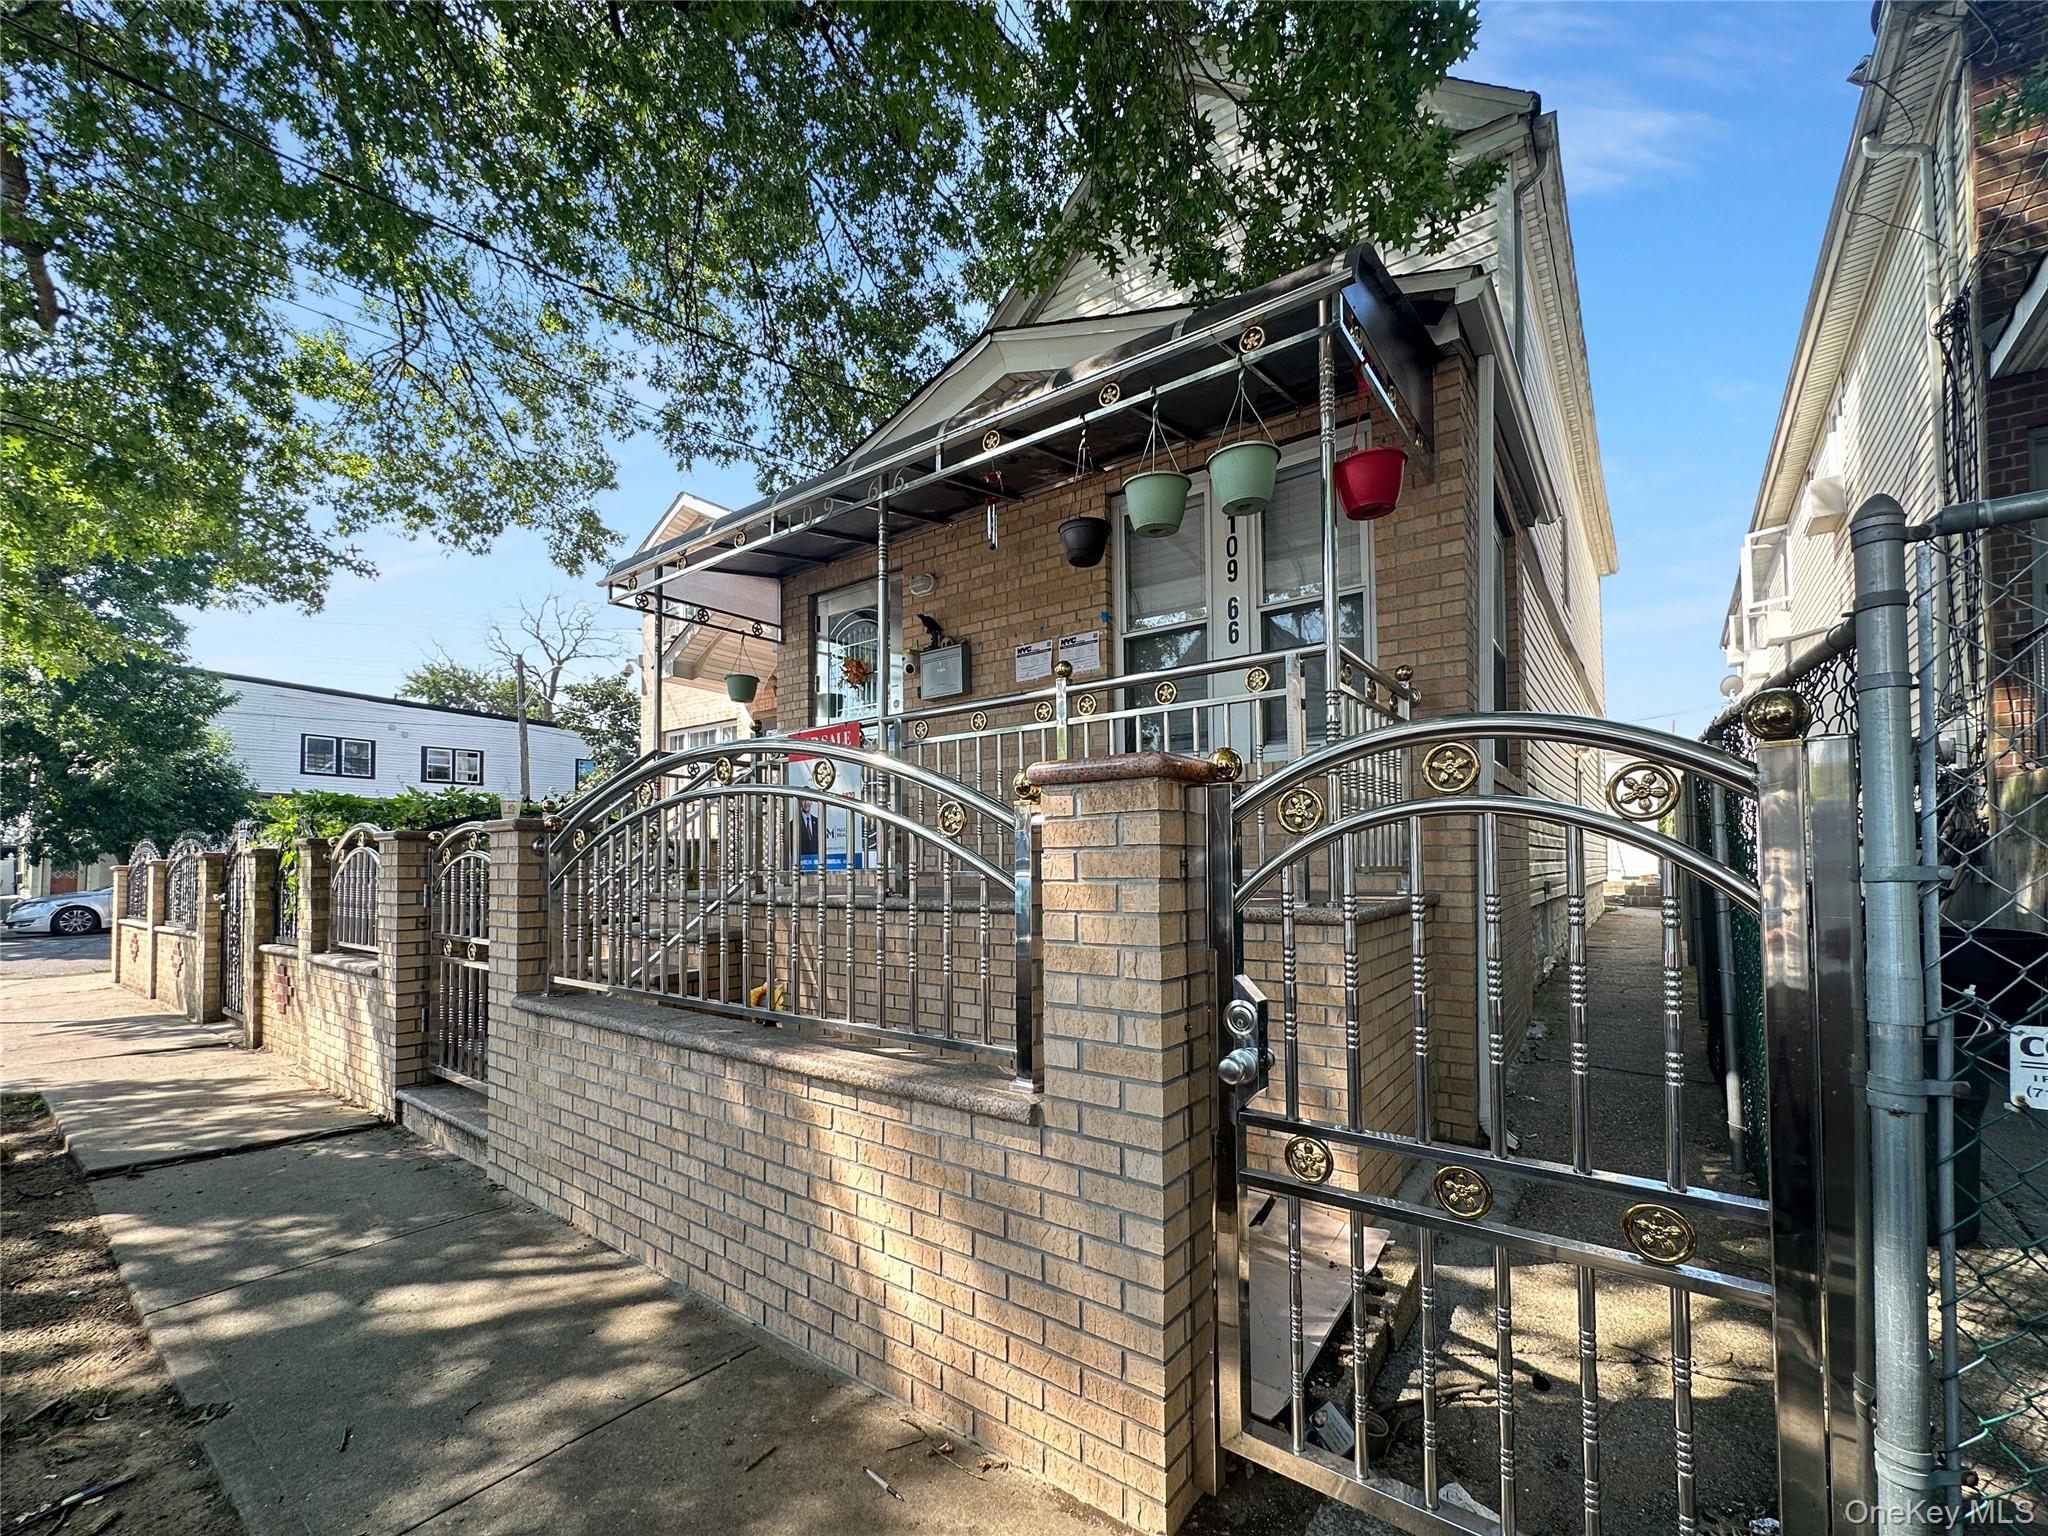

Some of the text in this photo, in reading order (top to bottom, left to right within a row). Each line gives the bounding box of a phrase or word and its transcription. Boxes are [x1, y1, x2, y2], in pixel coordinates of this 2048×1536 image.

[786, 497, 834, 532] 109
[1226, 515, 1240, 644] 109 66
[1017, 645, 1032, 655] NYC
[1060, 637, 1077, 646] NYC
[2020, 1036, 2048, 1057] C
